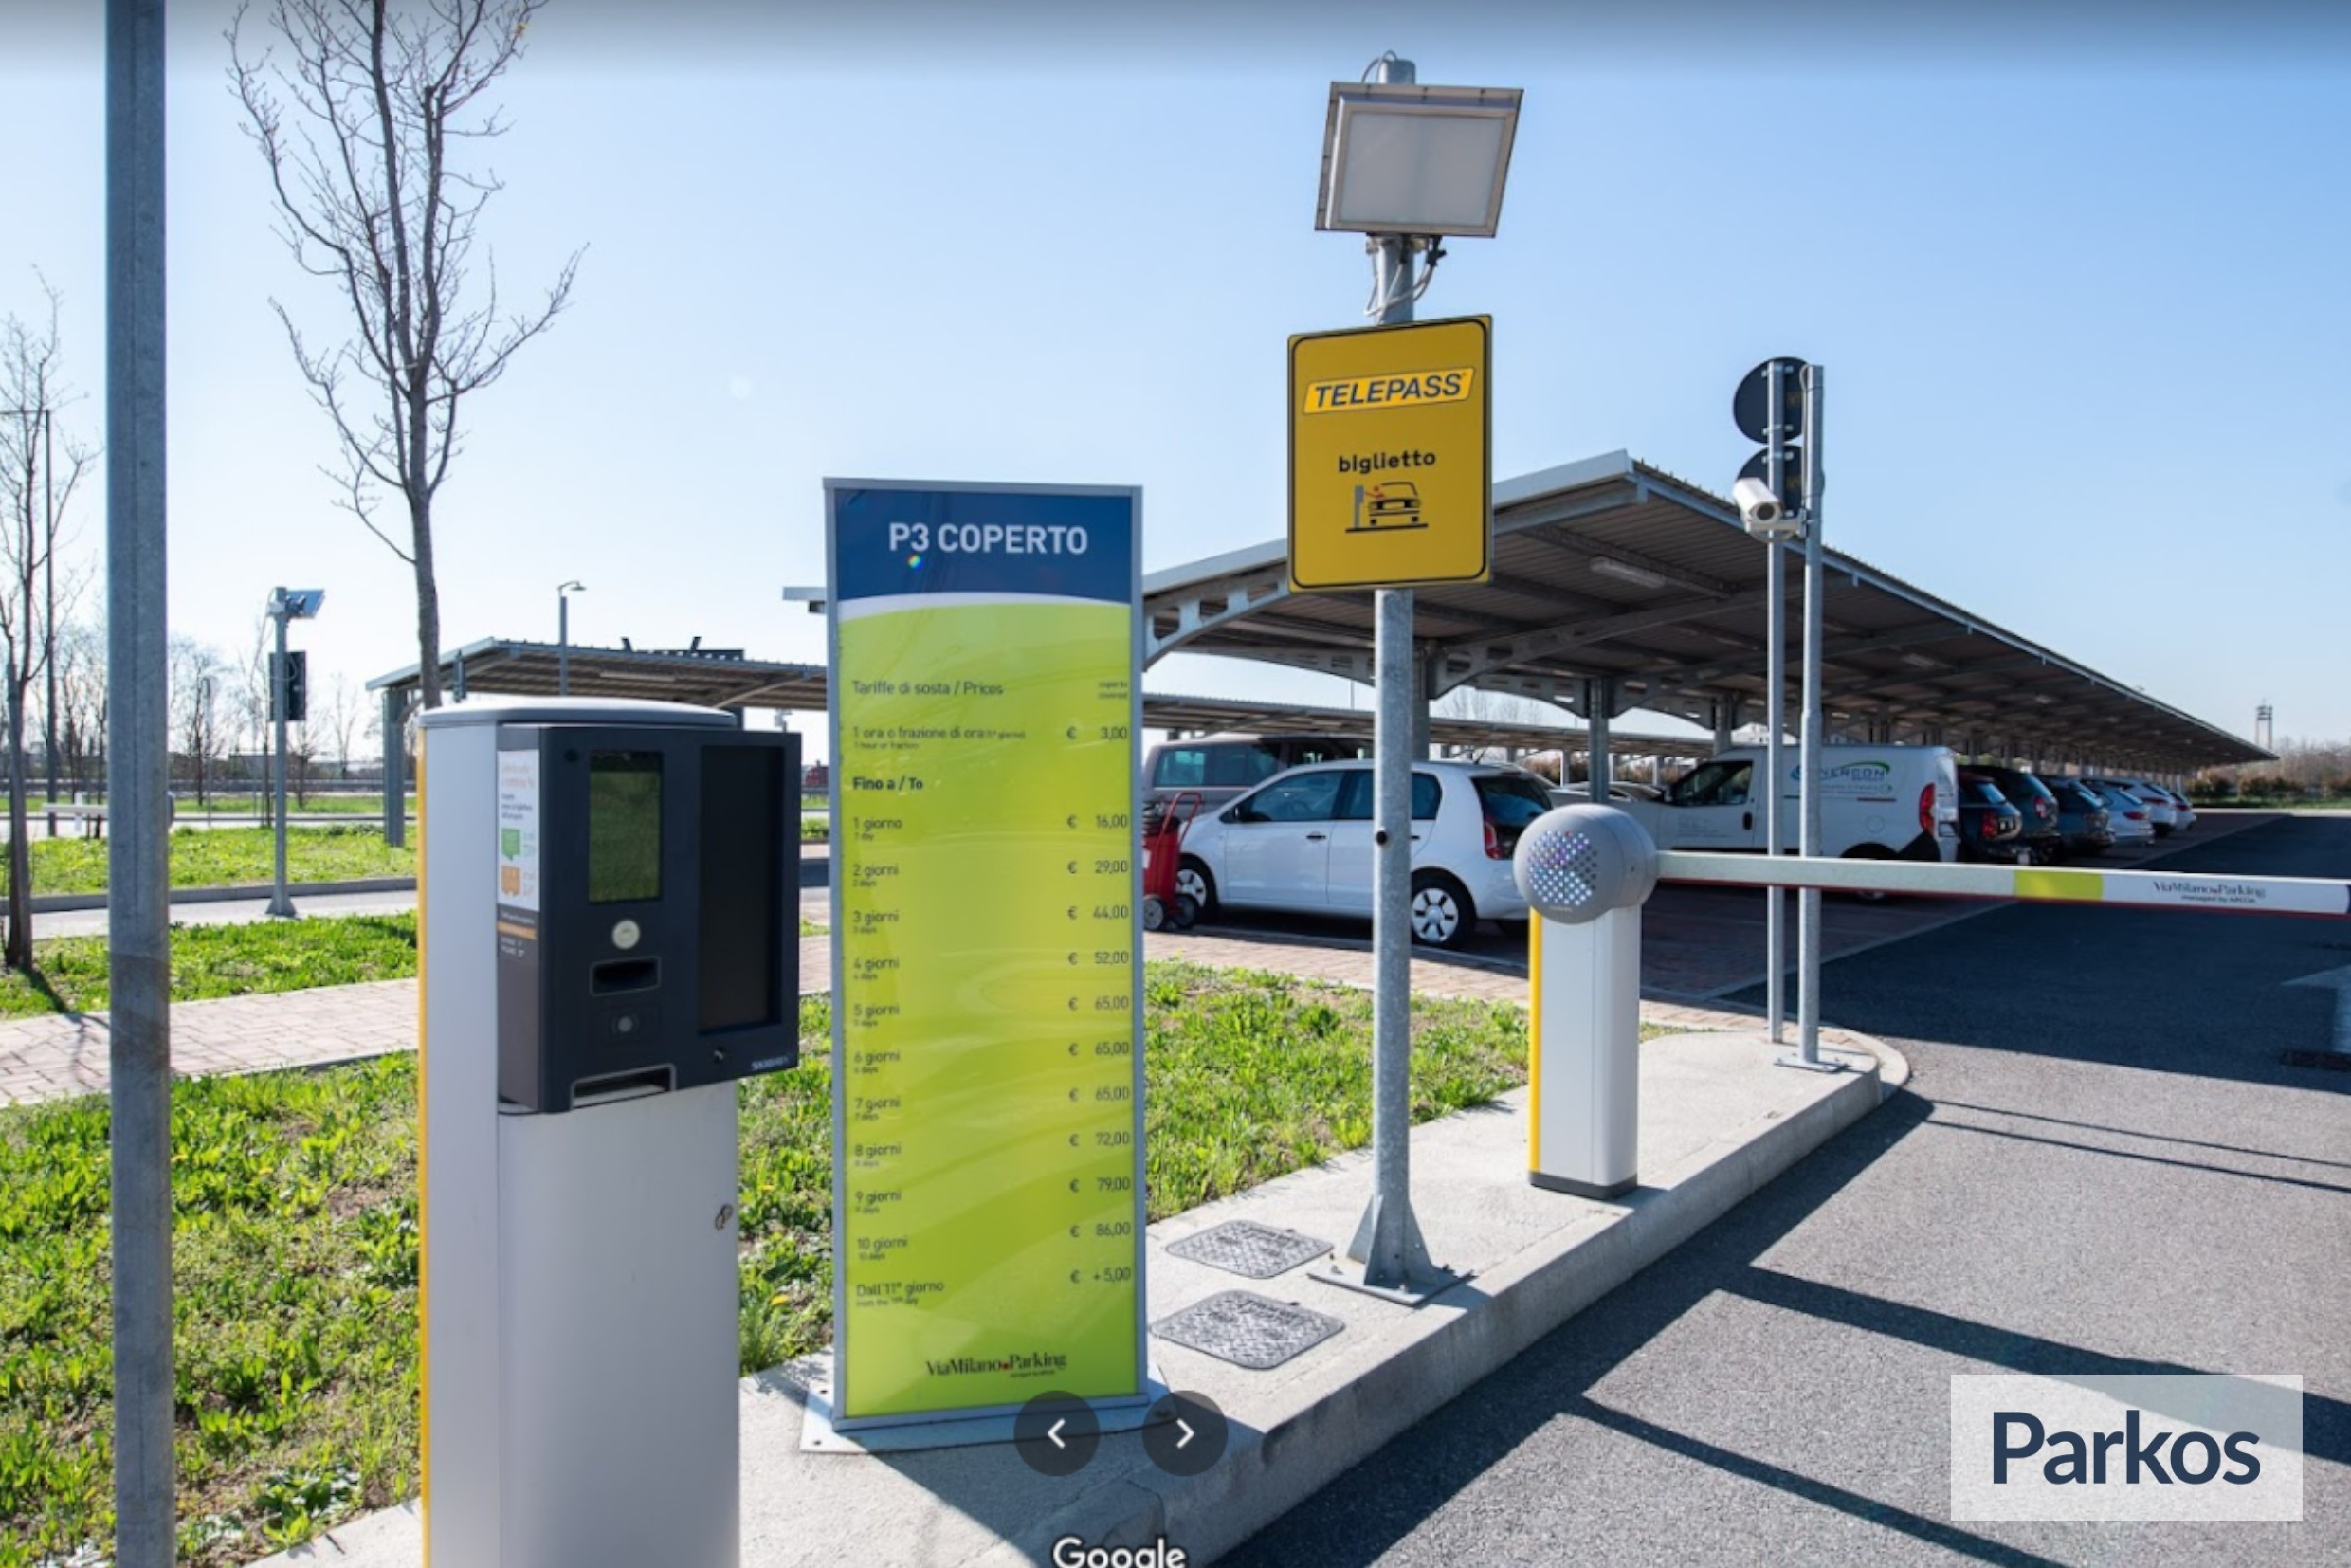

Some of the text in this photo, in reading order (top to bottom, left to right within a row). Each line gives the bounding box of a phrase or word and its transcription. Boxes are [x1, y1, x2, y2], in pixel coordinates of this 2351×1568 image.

[1315, 374, 1462, 408] TELEPASS
[1339, 450, 1436, 474] biglietto
[889, 522, 1088, 554] P3 COPERTO
[852, 680, 1003, 696] Tariffe di sosta / Prices
[864, 728, 884, 738] ora
[887, 728, 896, 738] o
[899, 726, 947, 739] frazione
[950, 726, 960, 739] di
[964, 729, 985, 739] ora
[1066, 726, 1077, 739] €
[1100, 726, 1127, 740] 3,00
[853, 775, 923, 791] Fino a / To
[853, 814, 1128, 832] 1 giorno € 16,00
[853, 860, 1129, 880] 2 giorni € 29,00
[853, 905, 1129, 925] 3 giorni € 44,00
[853, 951, 1129, 971] 4 giorni € 52,00
[854, 995, 1129, 1018] 5 giorni € 65,00
[854, 1042, 1130, 1066] 6 giorni € 65,00
[855, 1086, 1129, 1112] 7 giorni € 65,00
[855, 1132, 1130, 1158] 8 giorni € 72,00
[855, 1177, 1130, 1205] 9 giorni € 79,00
[857, 1222, 1131, 1252] 10 giorni € 86,00
[904, 1280, 944, 1297] giorno
[1070, 1270, 1080, 1284] €
